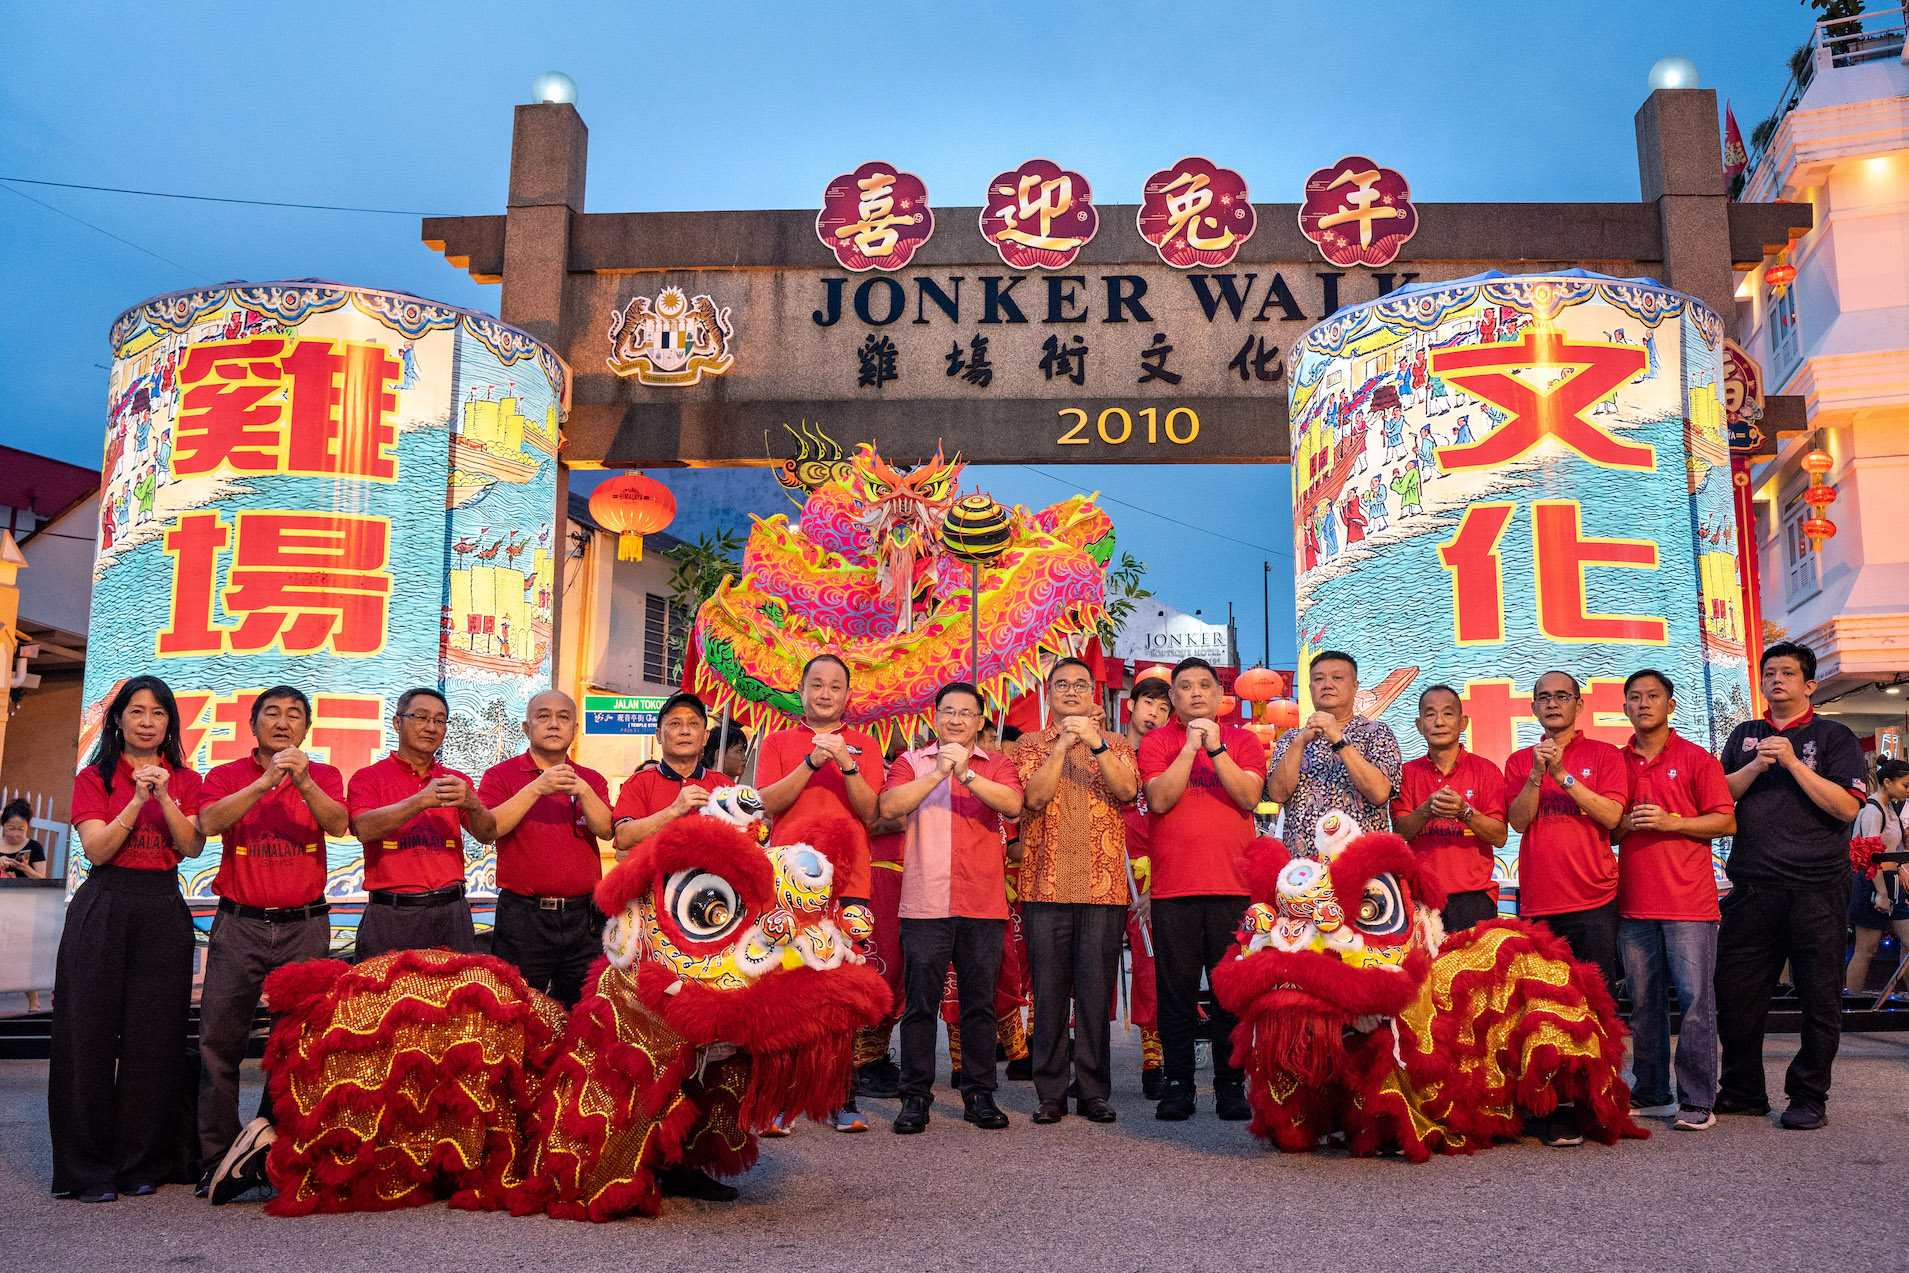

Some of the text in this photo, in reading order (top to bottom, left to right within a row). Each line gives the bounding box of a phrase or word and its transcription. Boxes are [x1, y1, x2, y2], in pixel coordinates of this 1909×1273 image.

[835, 169, 1399, 258] 喜迎兔年
[812, 273, 1153, 327] JONKER
[1056, 407, 1200, 446] 2010
[1145, 632, 1224, 649] JONKER
[1194, 648, 1221, 656] HOTEL
[613, 699, 639, 709] JALAN
[249, 843, 305, 858] HIMALAYA
[261, 858, 295, 871] Sports
